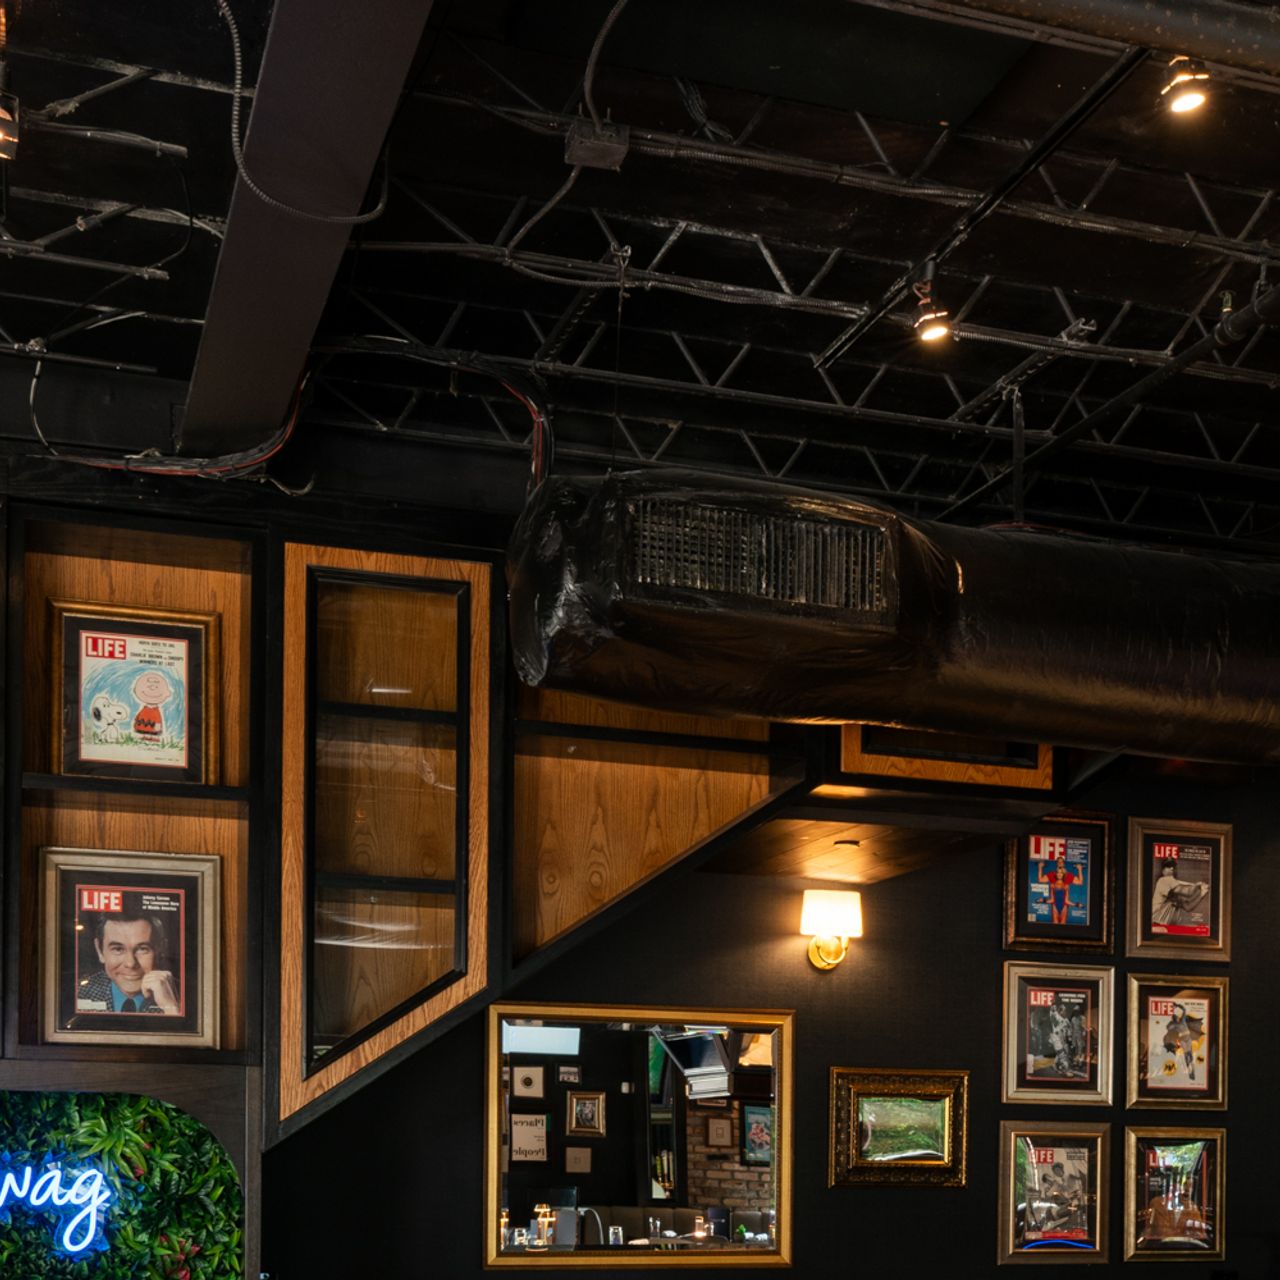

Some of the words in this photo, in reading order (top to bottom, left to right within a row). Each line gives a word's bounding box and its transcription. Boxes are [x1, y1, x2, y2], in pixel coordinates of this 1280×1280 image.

[86, 638, 125, 659] LIFE
[1030, 836, 1066, 861] LIFE
[1154, 845, 1179, 859] LIFE
[82, 891, 121, 911] LIFE
[1030, 991, 1055, 1006] LIFE
[1151, 1001, 1174, 1016] LIFE
